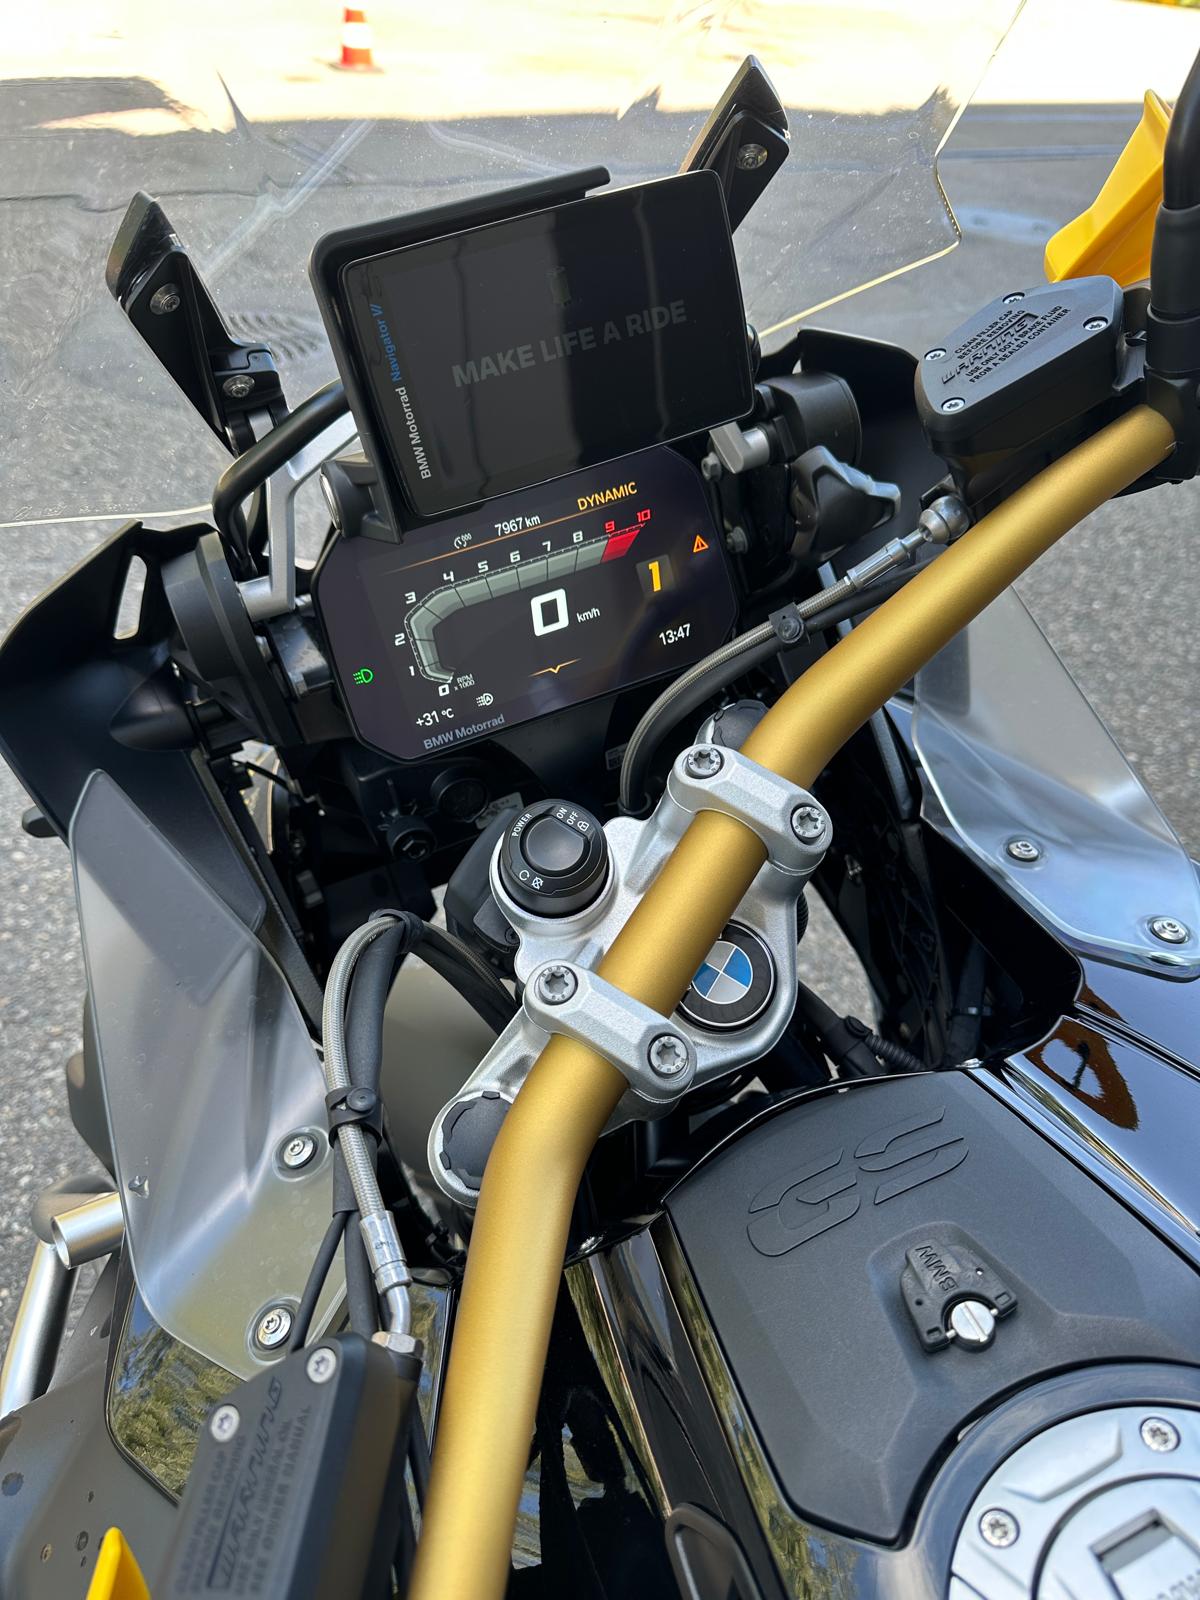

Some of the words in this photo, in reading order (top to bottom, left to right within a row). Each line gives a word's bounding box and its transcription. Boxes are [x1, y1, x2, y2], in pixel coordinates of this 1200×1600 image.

[955, 337, 979, 354] CLEAN
[976, 322, 999, 338] FILLER
[999, 310, 1013, 321] CAP
[958, 338, 989, 359] BEFORE
[987, 310, 1025, 338] REMOVING
[965, 365, 982, 377] USE
[981, 353, 999, 366] ONLY
[1000, 342, 1014, 353] DOT
[1019, 321, 1043, 338] BRAKE
[1041, 305, 1062, 320] FLUID
[377, 320, 402, 382] Navigator
[451, 344, 536, 388] MAKE
[539, 327, 597, 362] LIFE
[603, 320, 621, 344] A
[625, 300, 687, 337] RIDE
[969, 366, 992, 383] FROM
[1001, 341, 1028, 362] SEALED
[1029, 308, 1071, 340] CONTAINER
[395, 387, 421, 445] Motorrad
[413, 446, 432, 479] BMW
[577, 481, 638, 511] DYNAMIC
[494, 517, 523, 537] 7967
[525, 514, 541, 528] km
[605, 520, 616, 533] 9
[636, 509, 651, 523] 10
[542, 541, 552, 552] 7
[573, 531, 584, 543] 8
[477, 560, 489, 573] 5
[509, 550, 521, 563] 6
[443, 570, 455, 582] 4
[648, 560, 662, 592] 1
[404, 591, 417, 604] 3
[530, 588, 570, 637] 0
[576, 607, 601, 623] km/h
[394, 632, 406, 646] 2
[658, 623, 691, 645] 13:47
[408, 665, 415, 676] 1
[456, 673, 473, 684] RPM
[438, 684, 450, 697] 0
[416, 710, 440, 726] +31
[441, 708, 454, 719] °C
[423, 731, 453, 750] BMW
[455, 714, 505, 739] Motorrad
[556, 807, 568, 819] ON
[566, 811, 579, 825] OFF
[511, 813, 533, 837] POWER
[747, 1106, 970, 1257] GS
[914, 1245, 959, 1291] BMW
